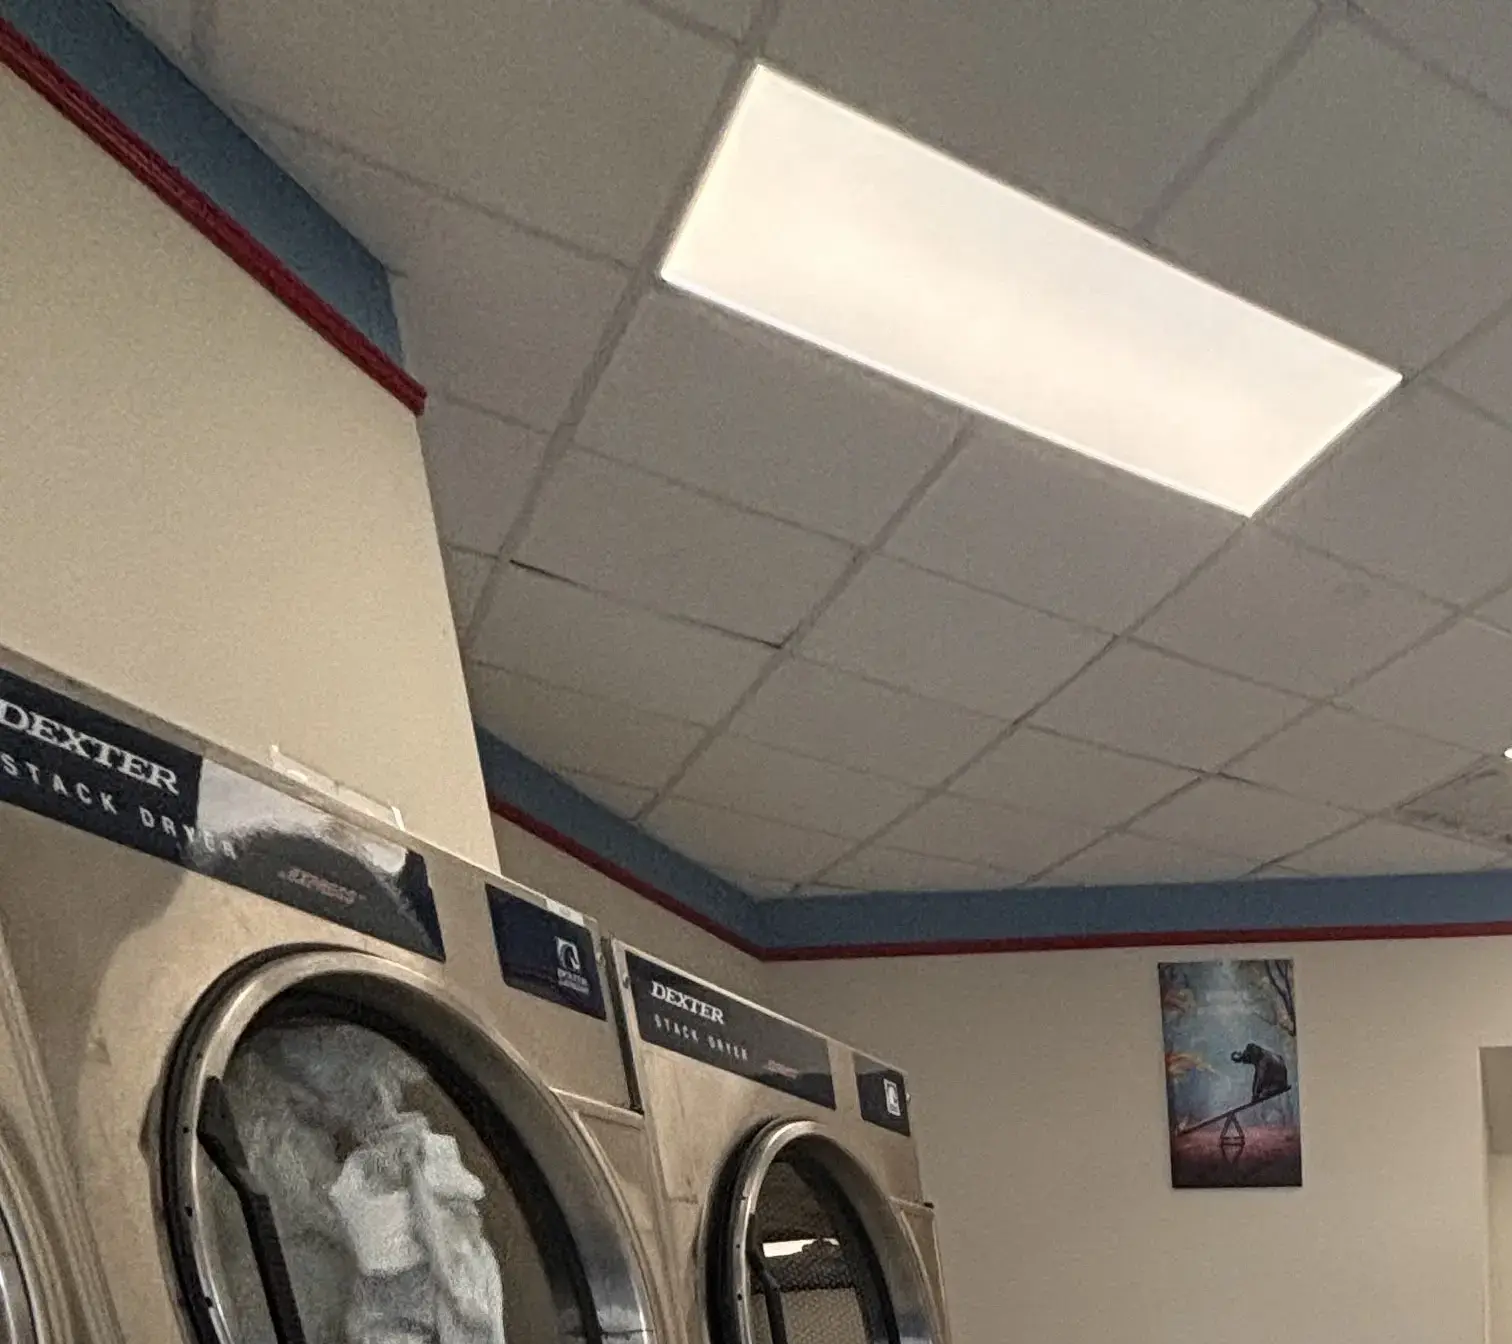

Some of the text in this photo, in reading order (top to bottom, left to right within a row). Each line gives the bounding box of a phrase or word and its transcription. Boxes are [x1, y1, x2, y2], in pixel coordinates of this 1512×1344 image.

[0, 698, 180, 796] DEXTER
[0, 752, 237, 861] STACK DRYER
[650, 979, 726, 1025] DEXTER
[654, 1013, 699, 1044] STACK
